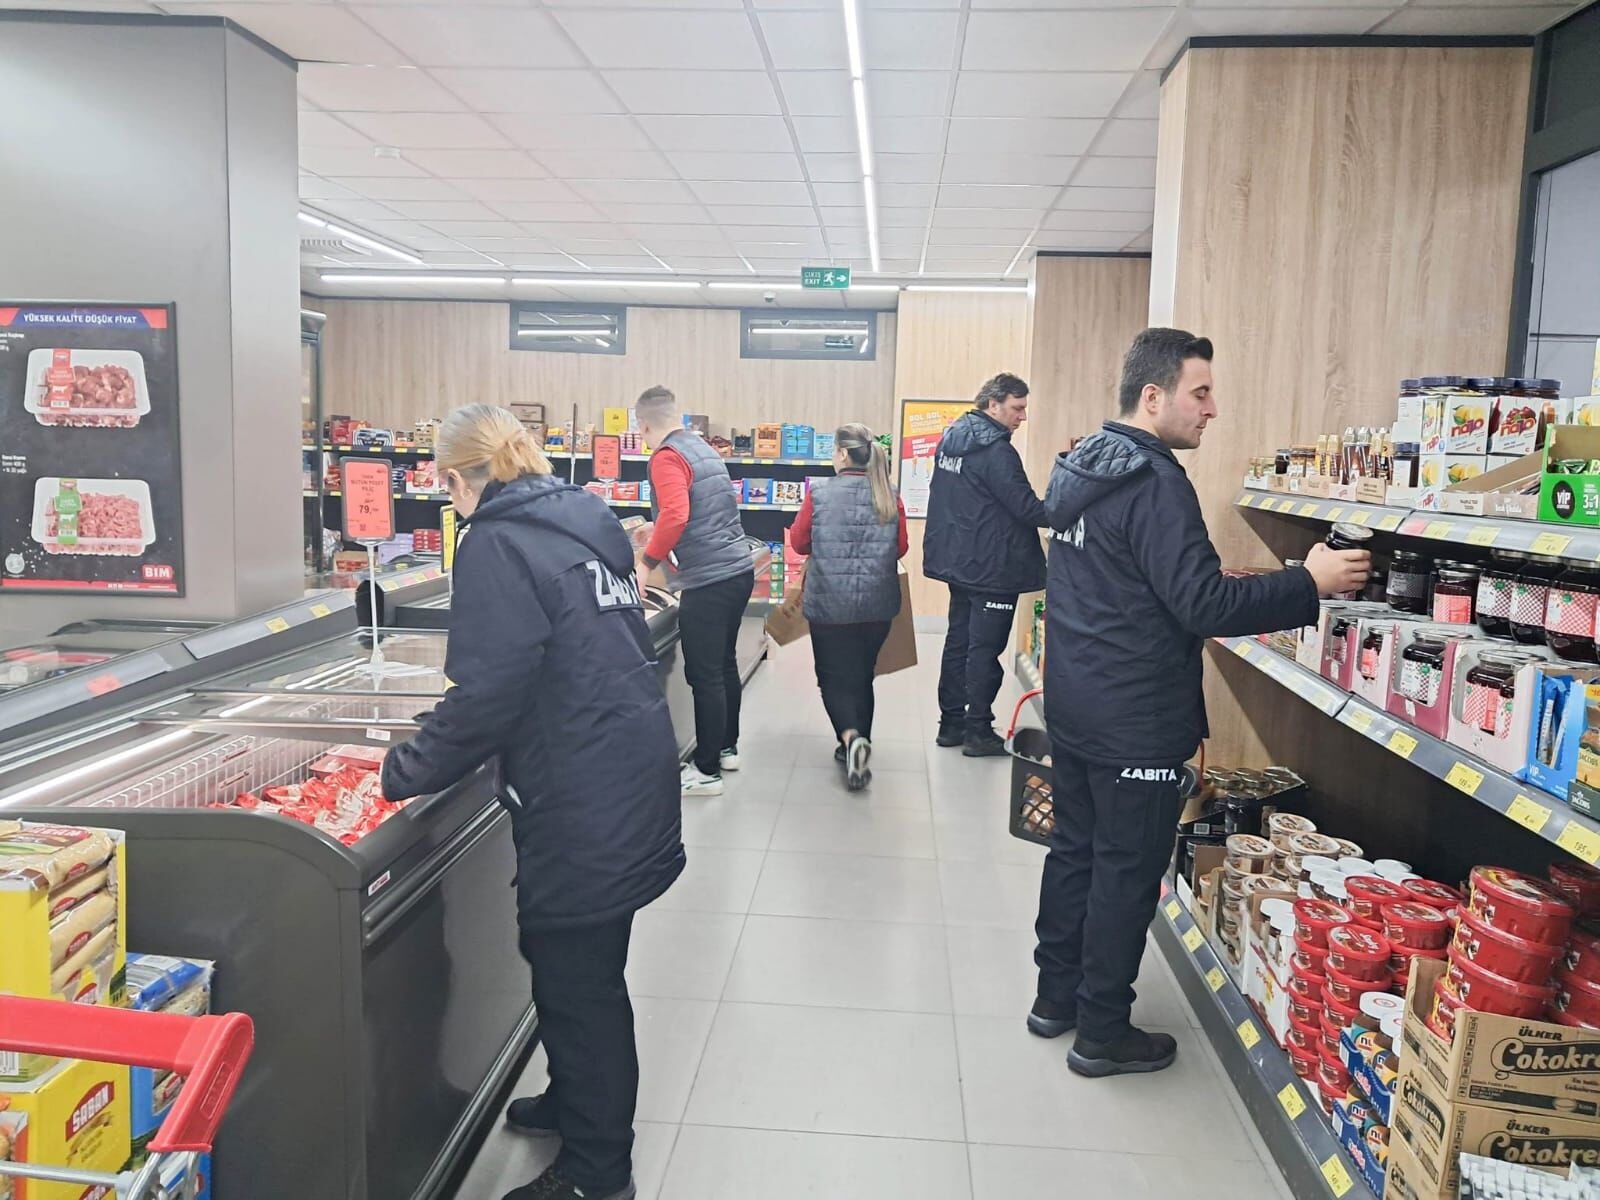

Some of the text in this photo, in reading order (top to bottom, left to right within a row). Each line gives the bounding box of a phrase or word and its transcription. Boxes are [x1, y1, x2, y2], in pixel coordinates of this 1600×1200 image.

[24, 313, 54, 322] YÜKSEK
[115, 315, 137, 324] FİYAT
[985, 601, 1014, 610] ZABITA
[1120, 767, 1177, 781] ZABITA
[1518, 1025, 1563, 1041] ÜLKER
[1506, 1120, 1551, 1136] ÜLKER
